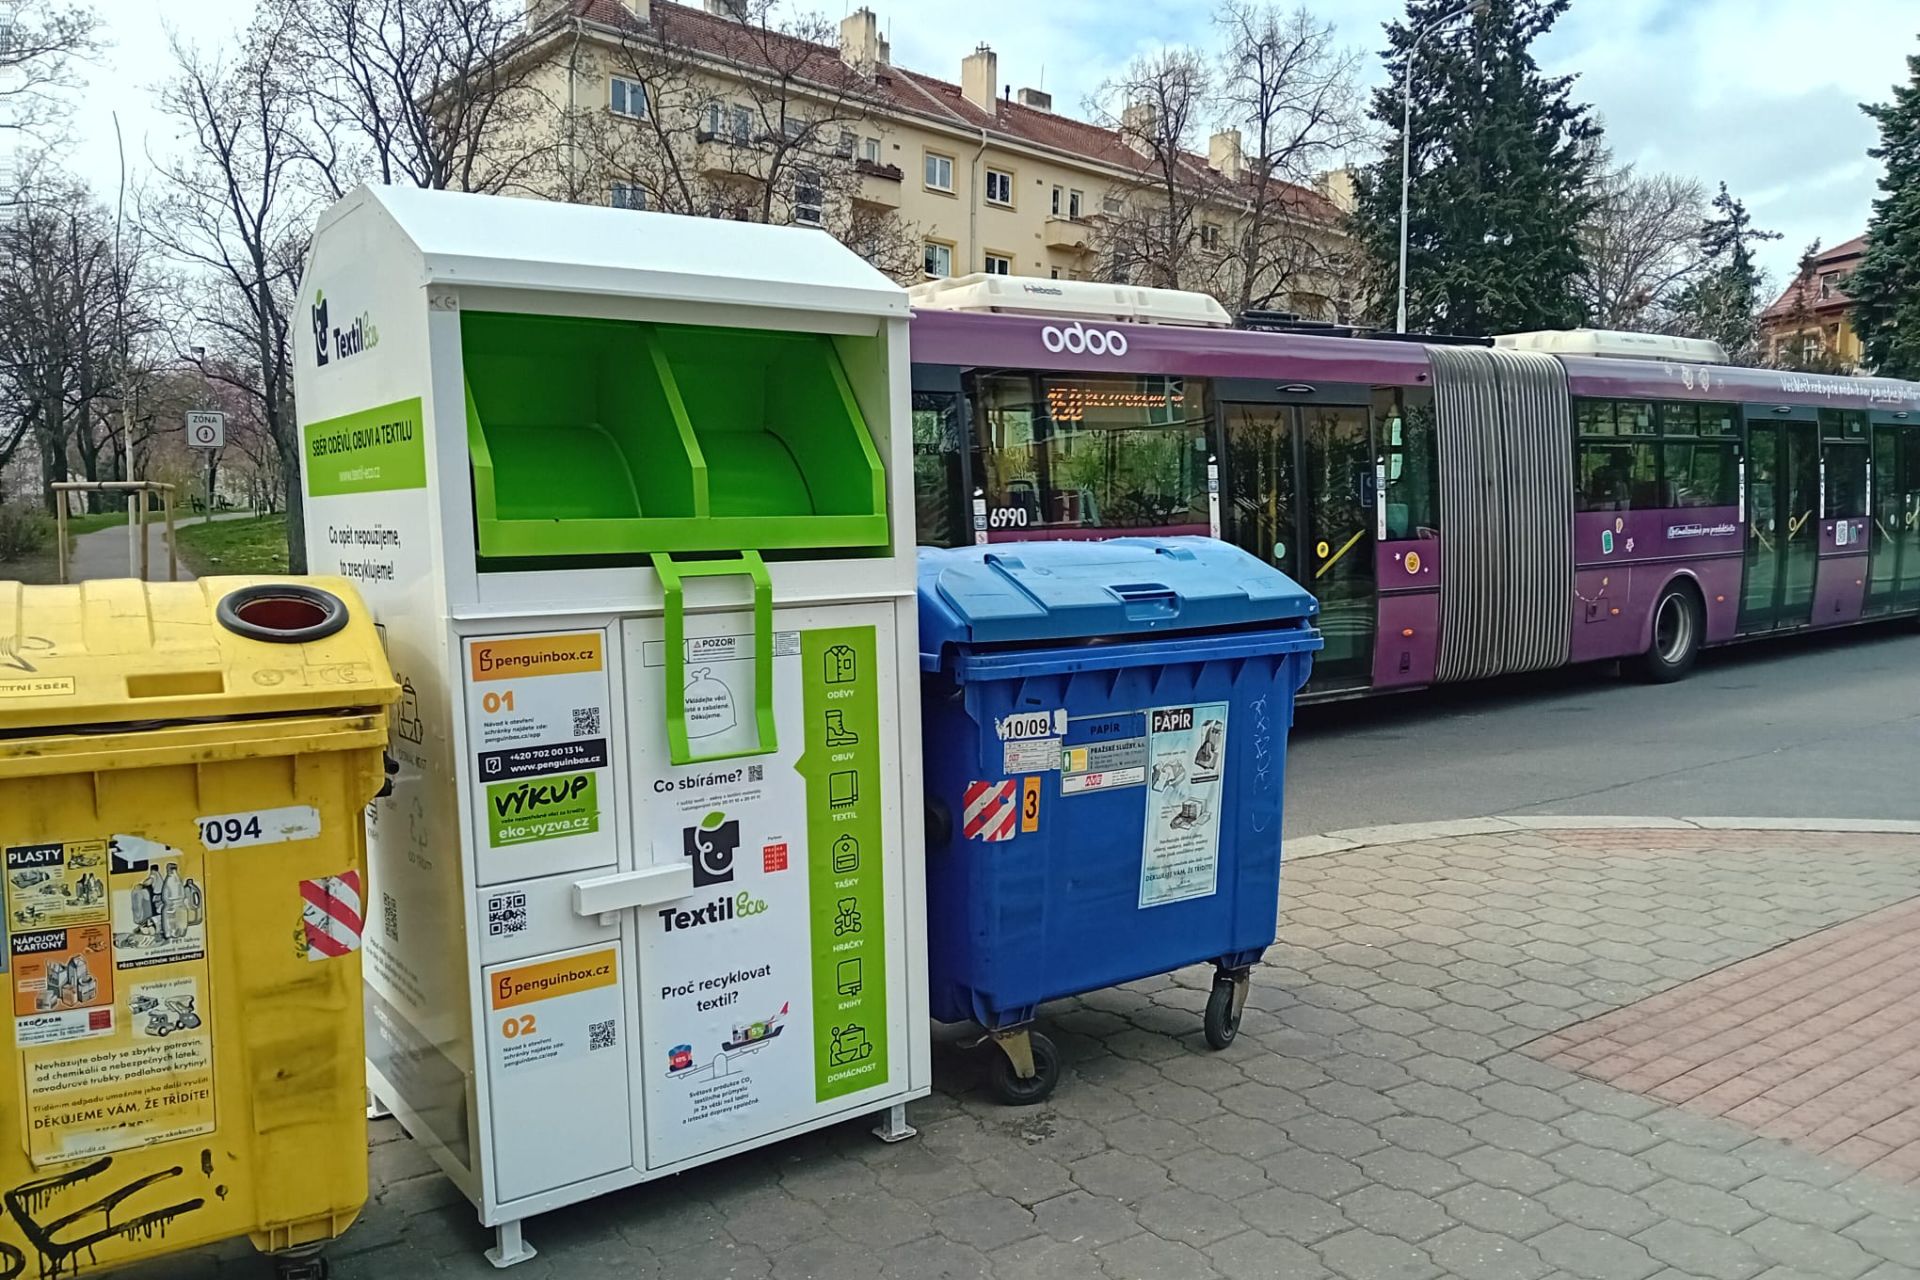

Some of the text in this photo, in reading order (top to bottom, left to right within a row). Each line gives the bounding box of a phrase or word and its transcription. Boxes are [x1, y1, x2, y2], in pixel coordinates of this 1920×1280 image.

[333, 317, 364, 360] Textil
[1041, 322, 1127, 356] odoo
[312, 434, 327, 456] SBĚR
[353, 428, 374, 449] OBUVI
[375, 427, 380, 445] A
[381, 420, 412, 444] TEXTILU
[990, 507, 1027, 528] 6990
[702, 638, 736, 648] POZOR!
[496, 650, 593, 669] penguinbox.cz
[482, 691, 514, 714] 01
[827, 688, 855, 699] ODĚVY
[1090, 722, 1120, 735] PAPÍR
[1154, 710, 1191, 731] PAPÍR
[510, 745, 584, 760] +420 702 00 13 14
[831, 752, 855, 762] OBUV
[510, 755, 601, 773] www.penguinbox.cz
[653, 769, 743, 793] Co sbíráme?
[495, 775, 588, 817] VÝKUP
[1025, 789, 1037, 819] 3
[832, 811, 857, 822] TEXTIL
[499, 817, 589, 839] eko-vyzva.cz
[8, 848, 61, 864] PLASTY
[834, 877, 859, 889] TAŠKY
[659, 891, 768, 932] Textil Eco
[13, 931, 65, 944] NÁPOJOVÉ
[16, 941, 62, 953] KARTONY
[833, 939, 864, 952] HRAČKY
[515, 965, 610, 995] penguinbox.cz
[662, 964, 771, 999] Proč recyklovat
[697, 991, 739, 1011] textil?
[838, 999, 862, 1011] KNIHY
[502, 1014, 536, 1039] 02
[34, 1058, 88, 1072] Nevhazujte
[90, 1051, 117, 1062] obaly
[132, 1045, 161, 1056] zbytky
[37, 1073, 49, 1082] od
[827, 1062, 877, 1083] DOMÁCNOST
[34, 1110, 103, 1129] DĚKUJEME
[107, 1102, 140, 1116] VÁM,
[144, 1097, 159, 1109] ŽE
[162, 1089, 209, 1105] TŘÍDÍTE!
